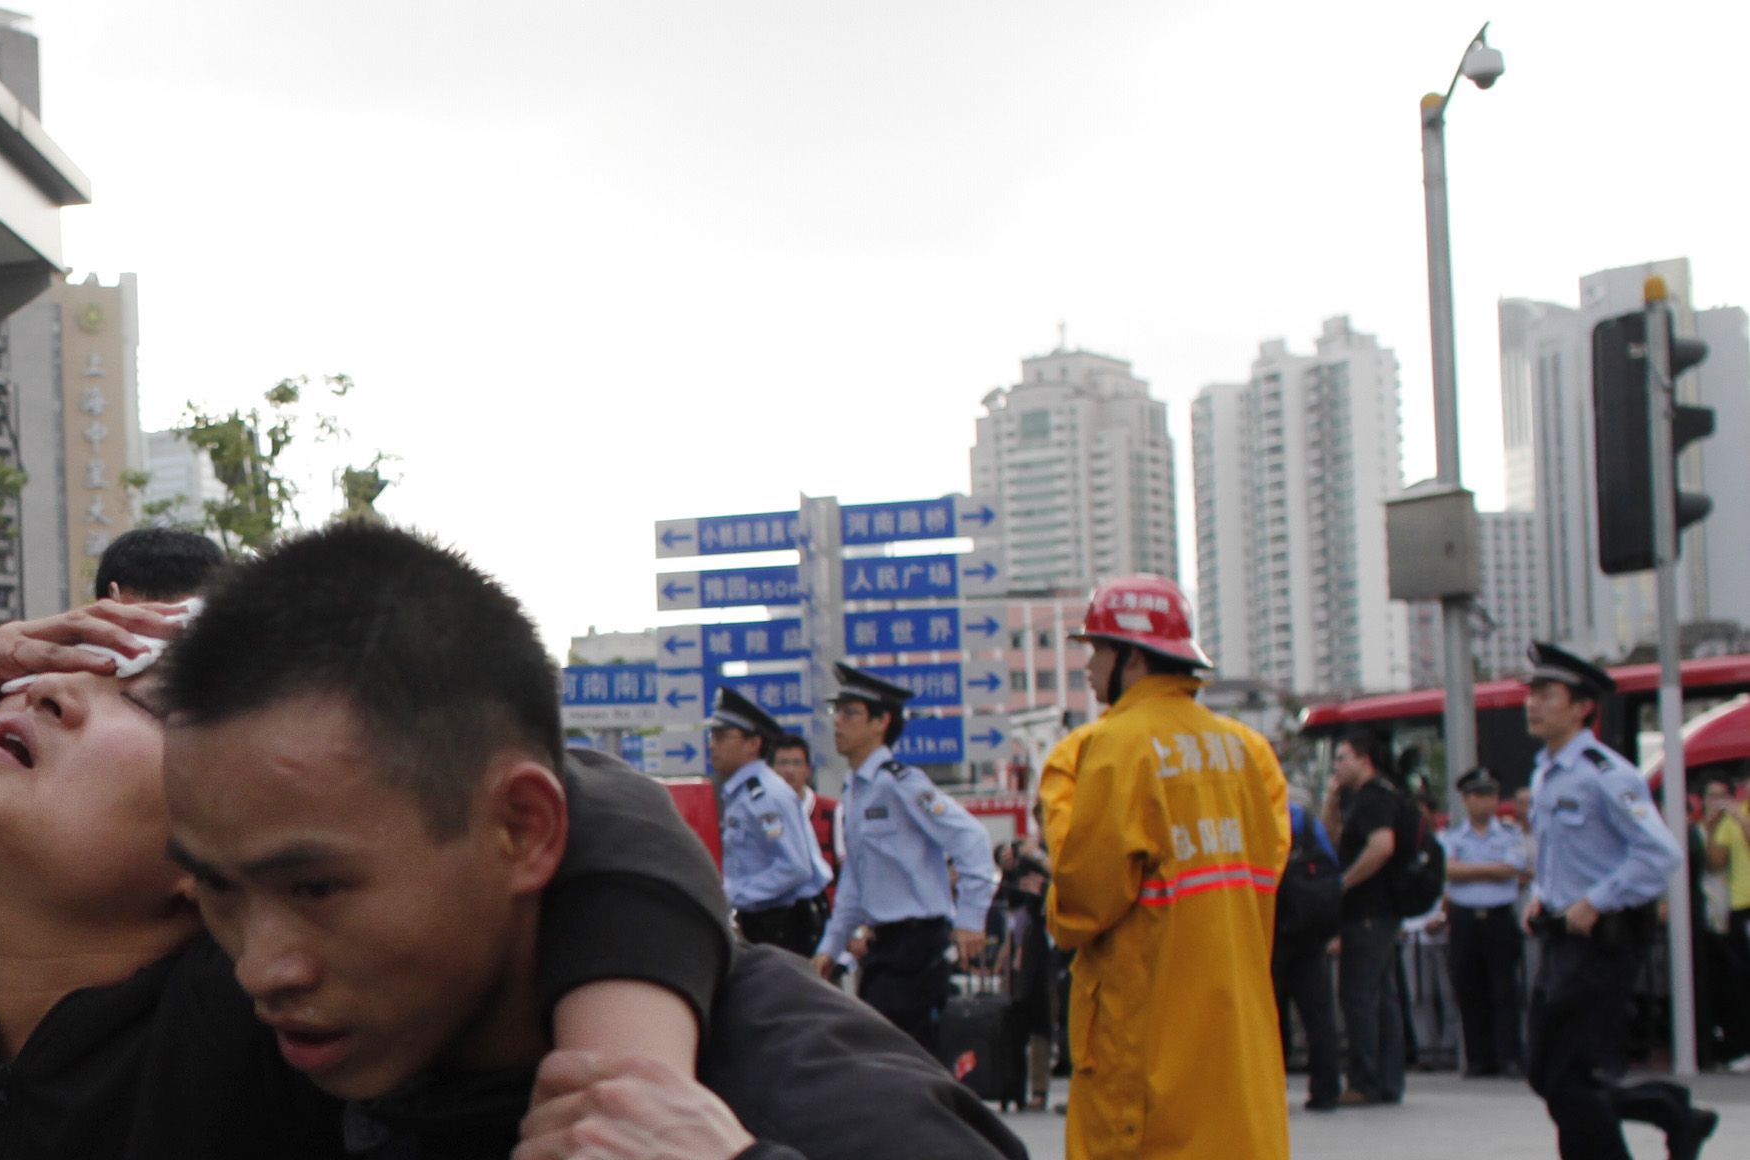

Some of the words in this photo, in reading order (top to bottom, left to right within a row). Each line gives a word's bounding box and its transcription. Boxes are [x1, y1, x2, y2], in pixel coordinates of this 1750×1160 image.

[850, 561, 952, 592] 人民广场
[854, 615, 953, 646] 新世界
[891, 735, 958, 755] 1.1km
